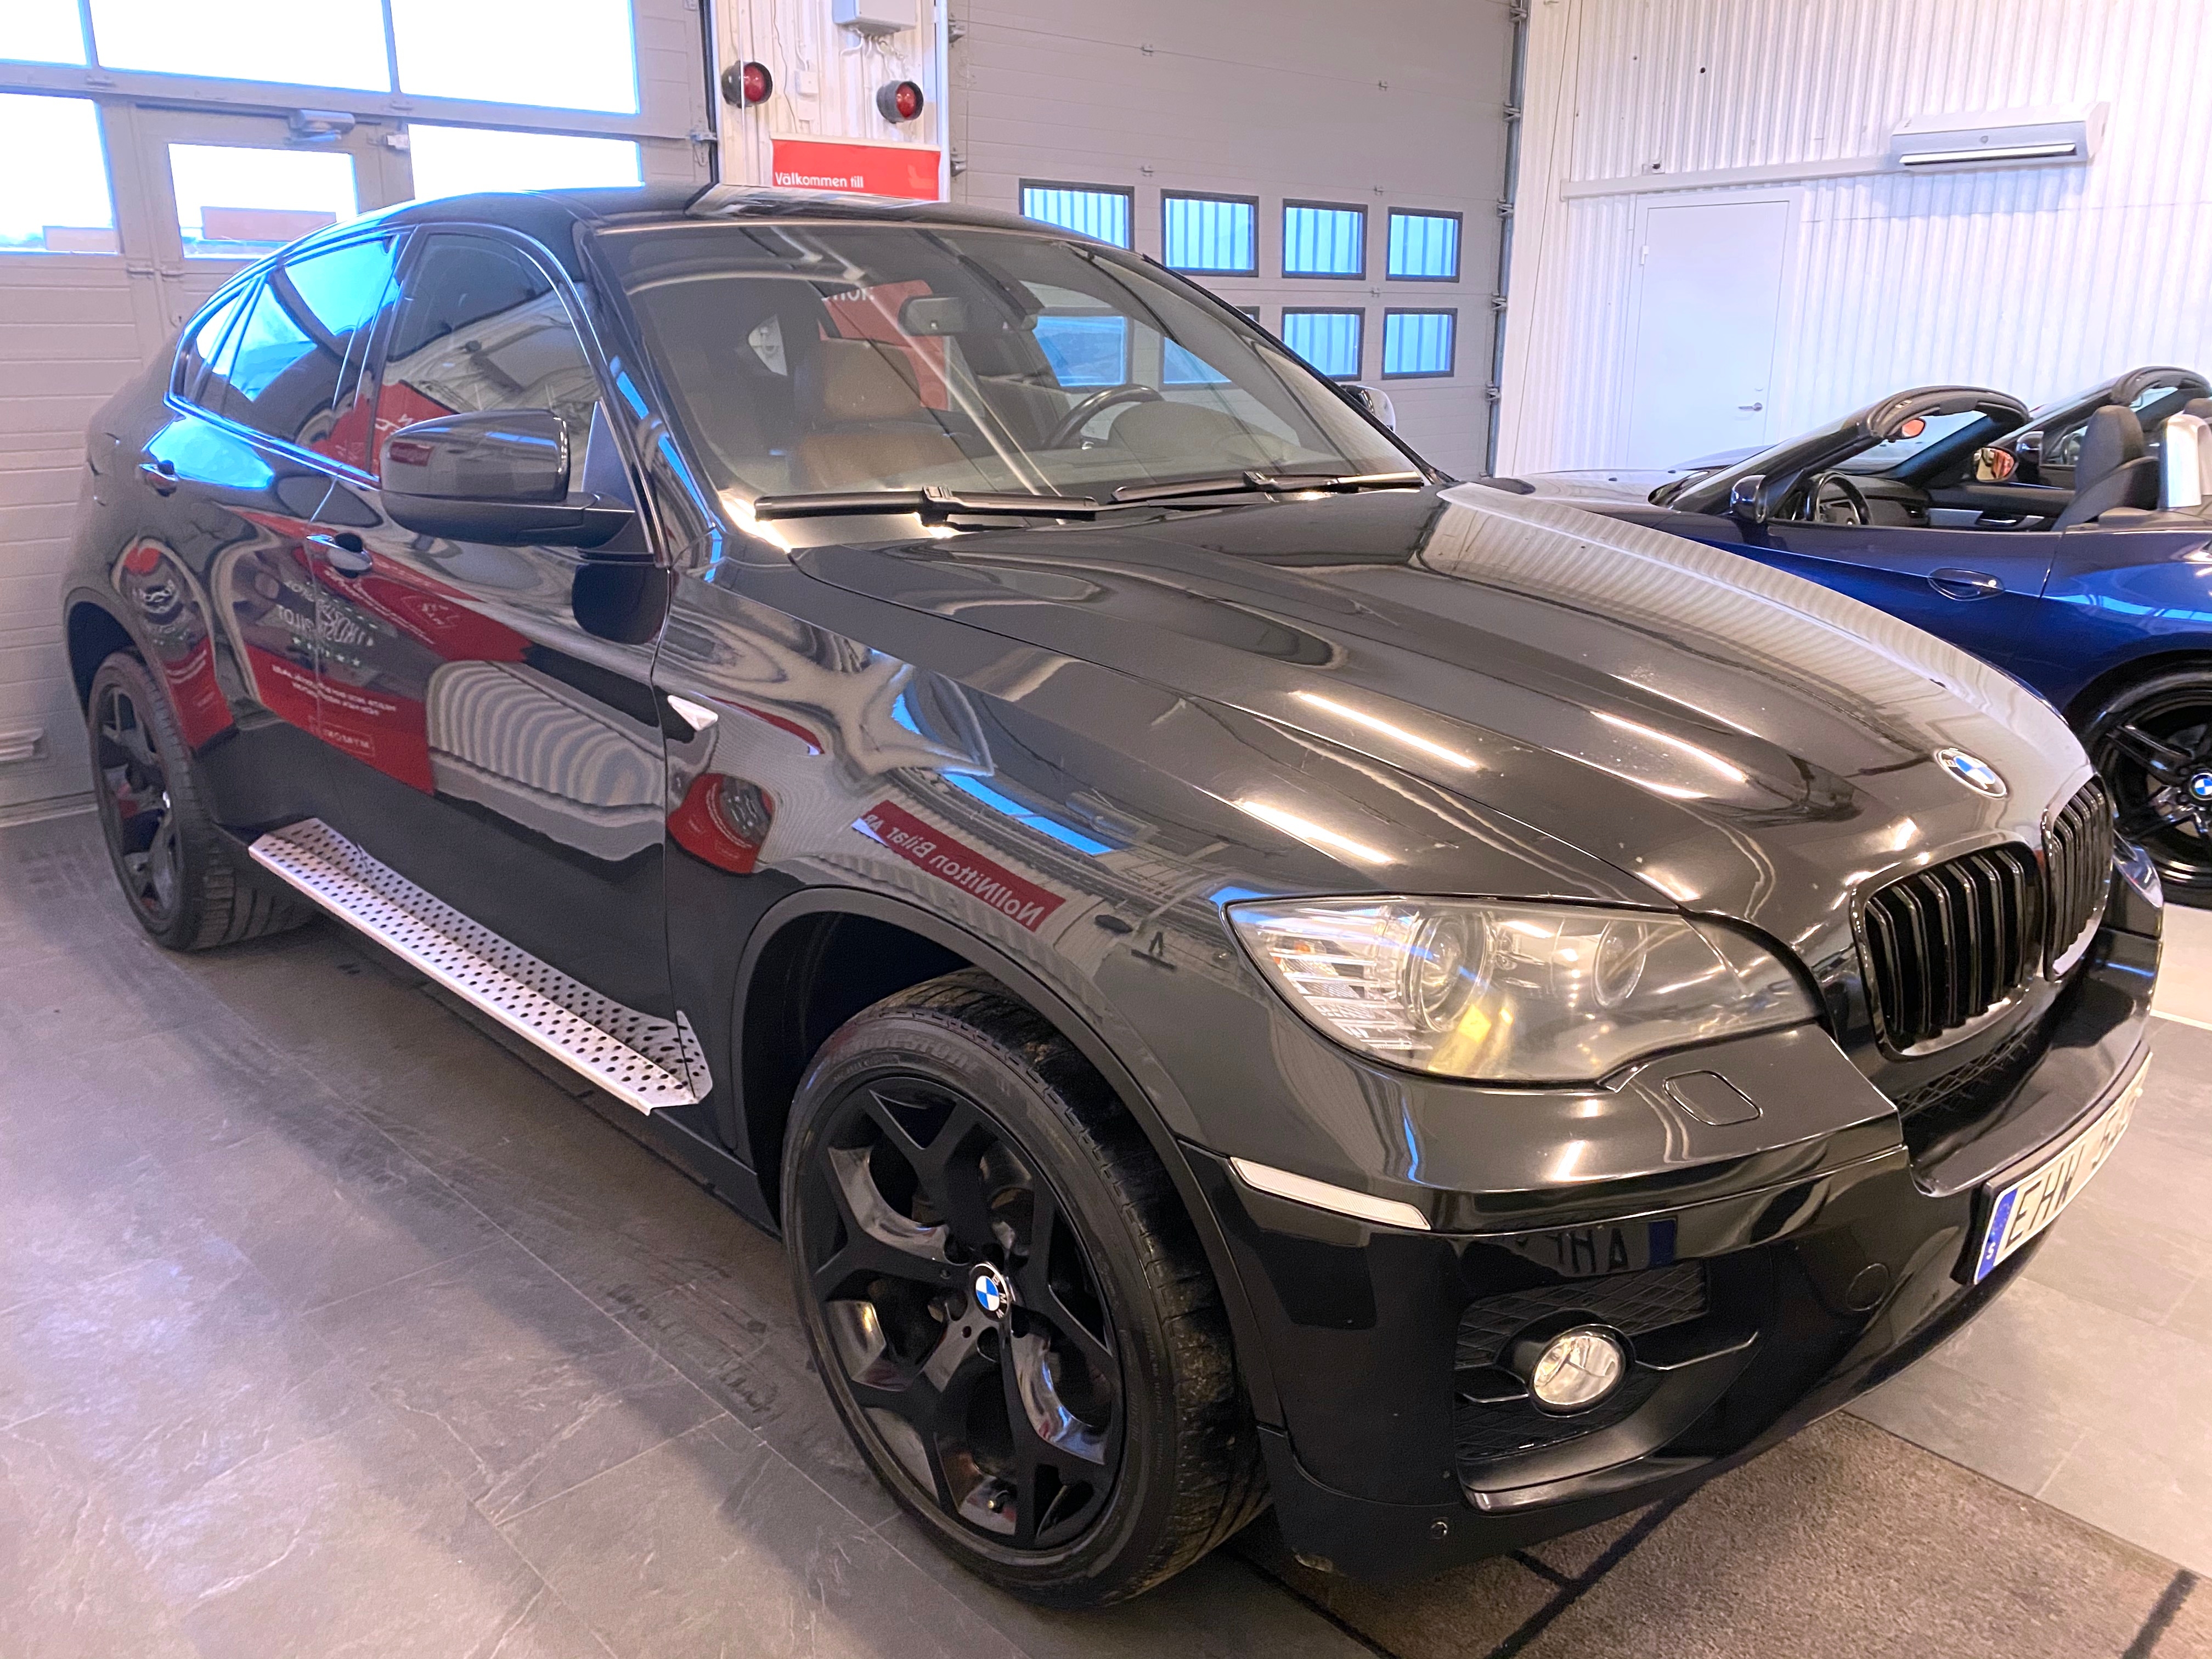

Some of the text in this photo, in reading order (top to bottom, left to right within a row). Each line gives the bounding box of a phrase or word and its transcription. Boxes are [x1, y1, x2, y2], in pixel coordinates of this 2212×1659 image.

[775, 172, 864, 188] Välkommen till
[991, 1272, 1008, 1319] BMW
